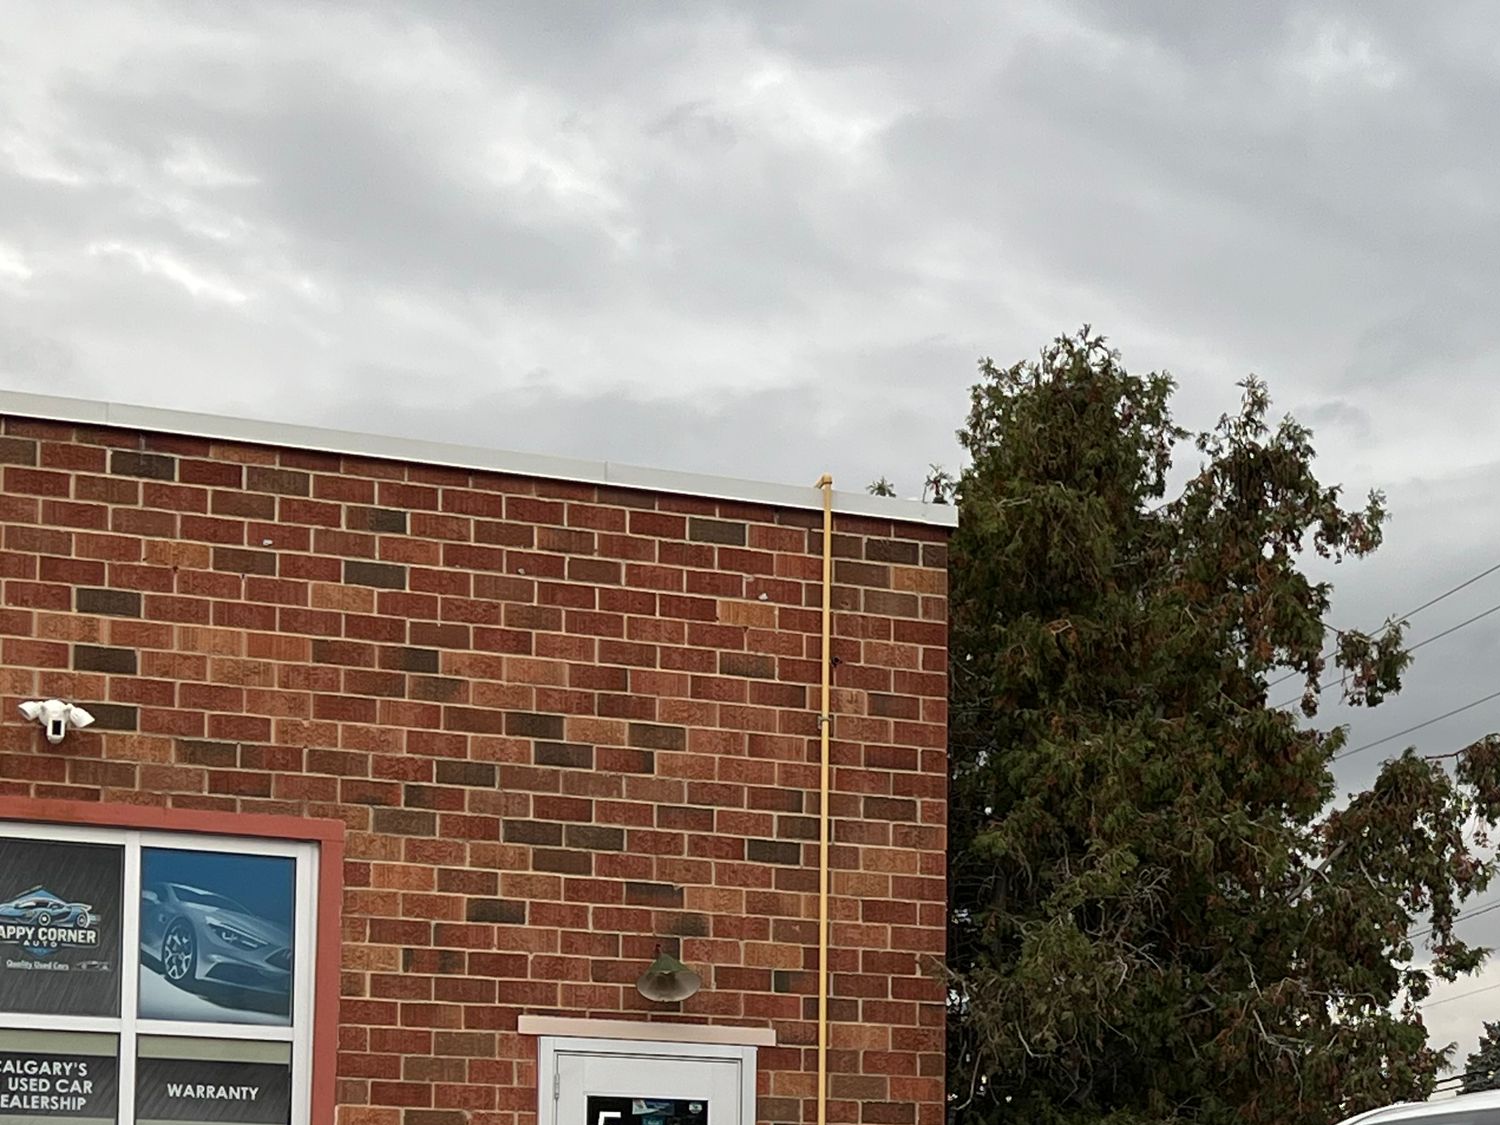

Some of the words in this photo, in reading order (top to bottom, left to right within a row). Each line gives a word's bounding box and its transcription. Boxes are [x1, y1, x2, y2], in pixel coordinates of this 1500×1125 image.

[23, 939, 58, 948] AUTO
[38, 928, 96, 943] CORNER
[0, 1059, 88, 1077] ALGARY'S
[8, 1077, 51, 1092] USED
[55, 1079, 93, 1094] CAR
[167, 1083, 259, 1101] WARRANTY
